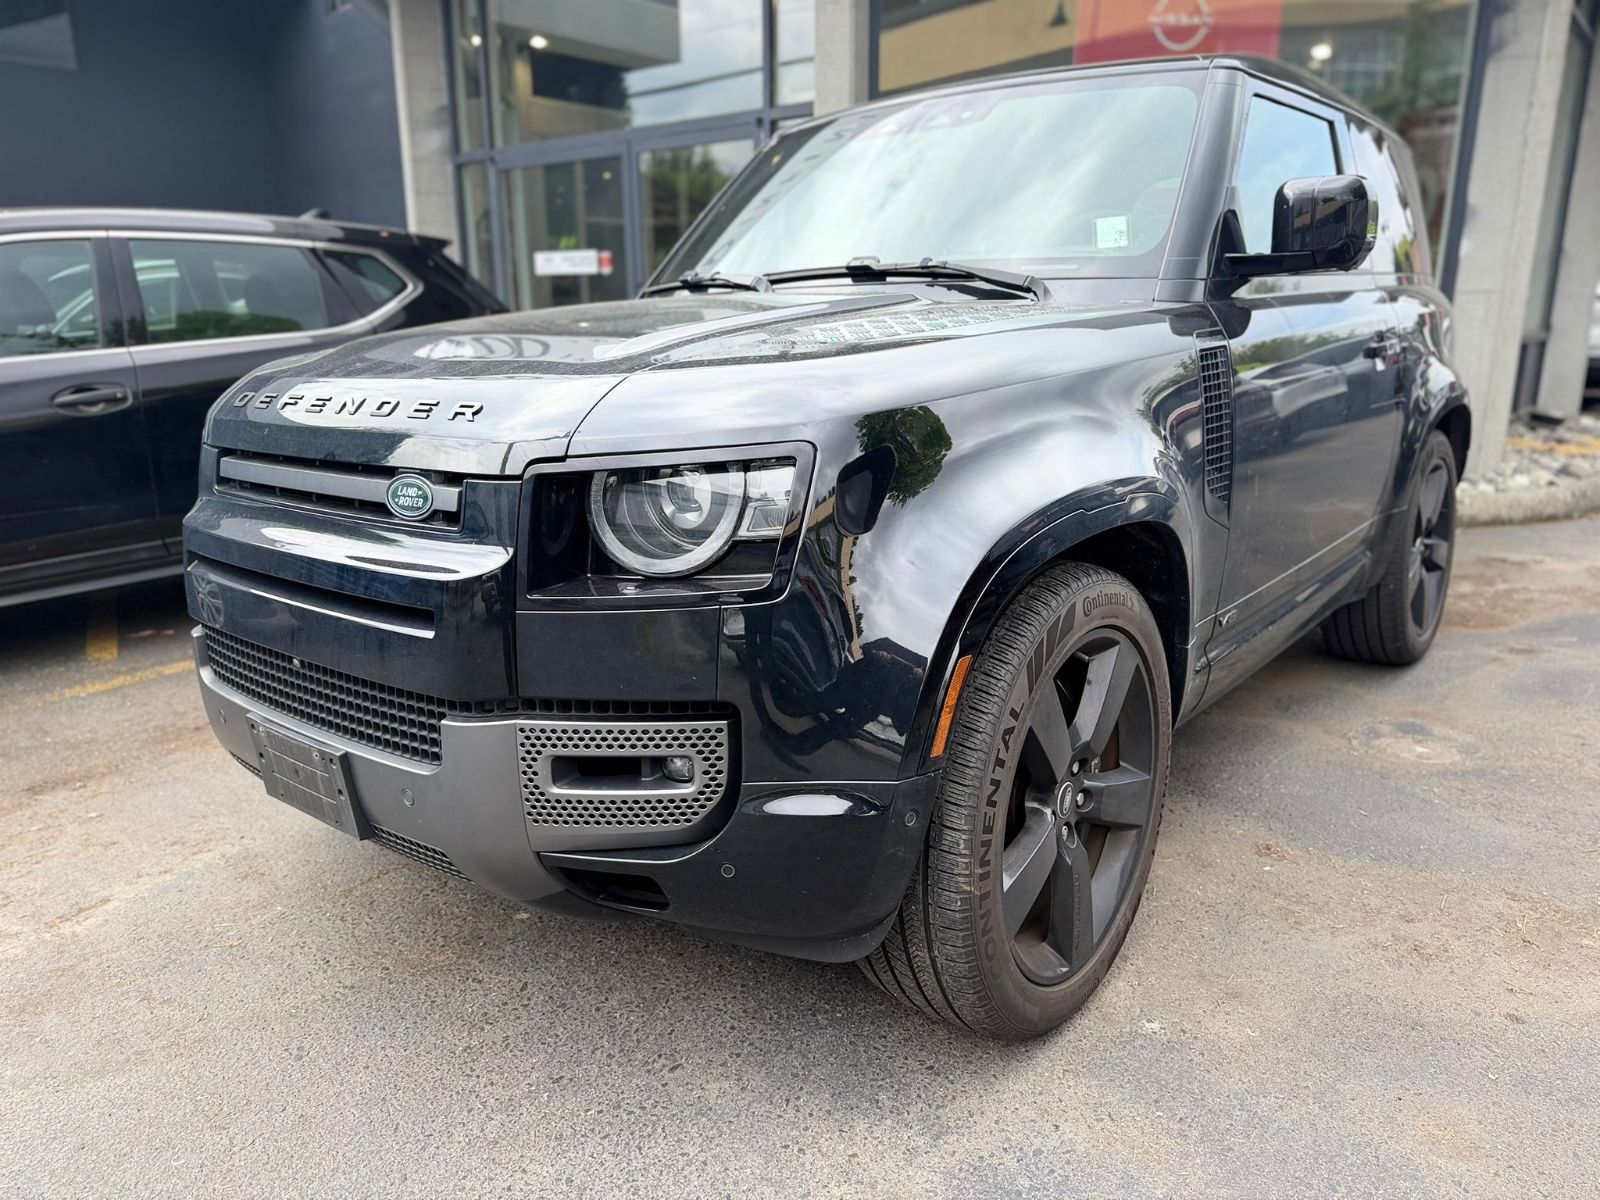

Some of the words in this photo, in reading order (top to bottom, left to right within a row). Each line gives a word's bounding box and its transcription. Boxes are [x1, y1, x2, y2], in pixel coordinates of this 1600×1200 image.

[233, 391, 484, 422] DEFENDER
[397, 485, 418, 497] LAND
[398, 496, 424, 508] ROVER
